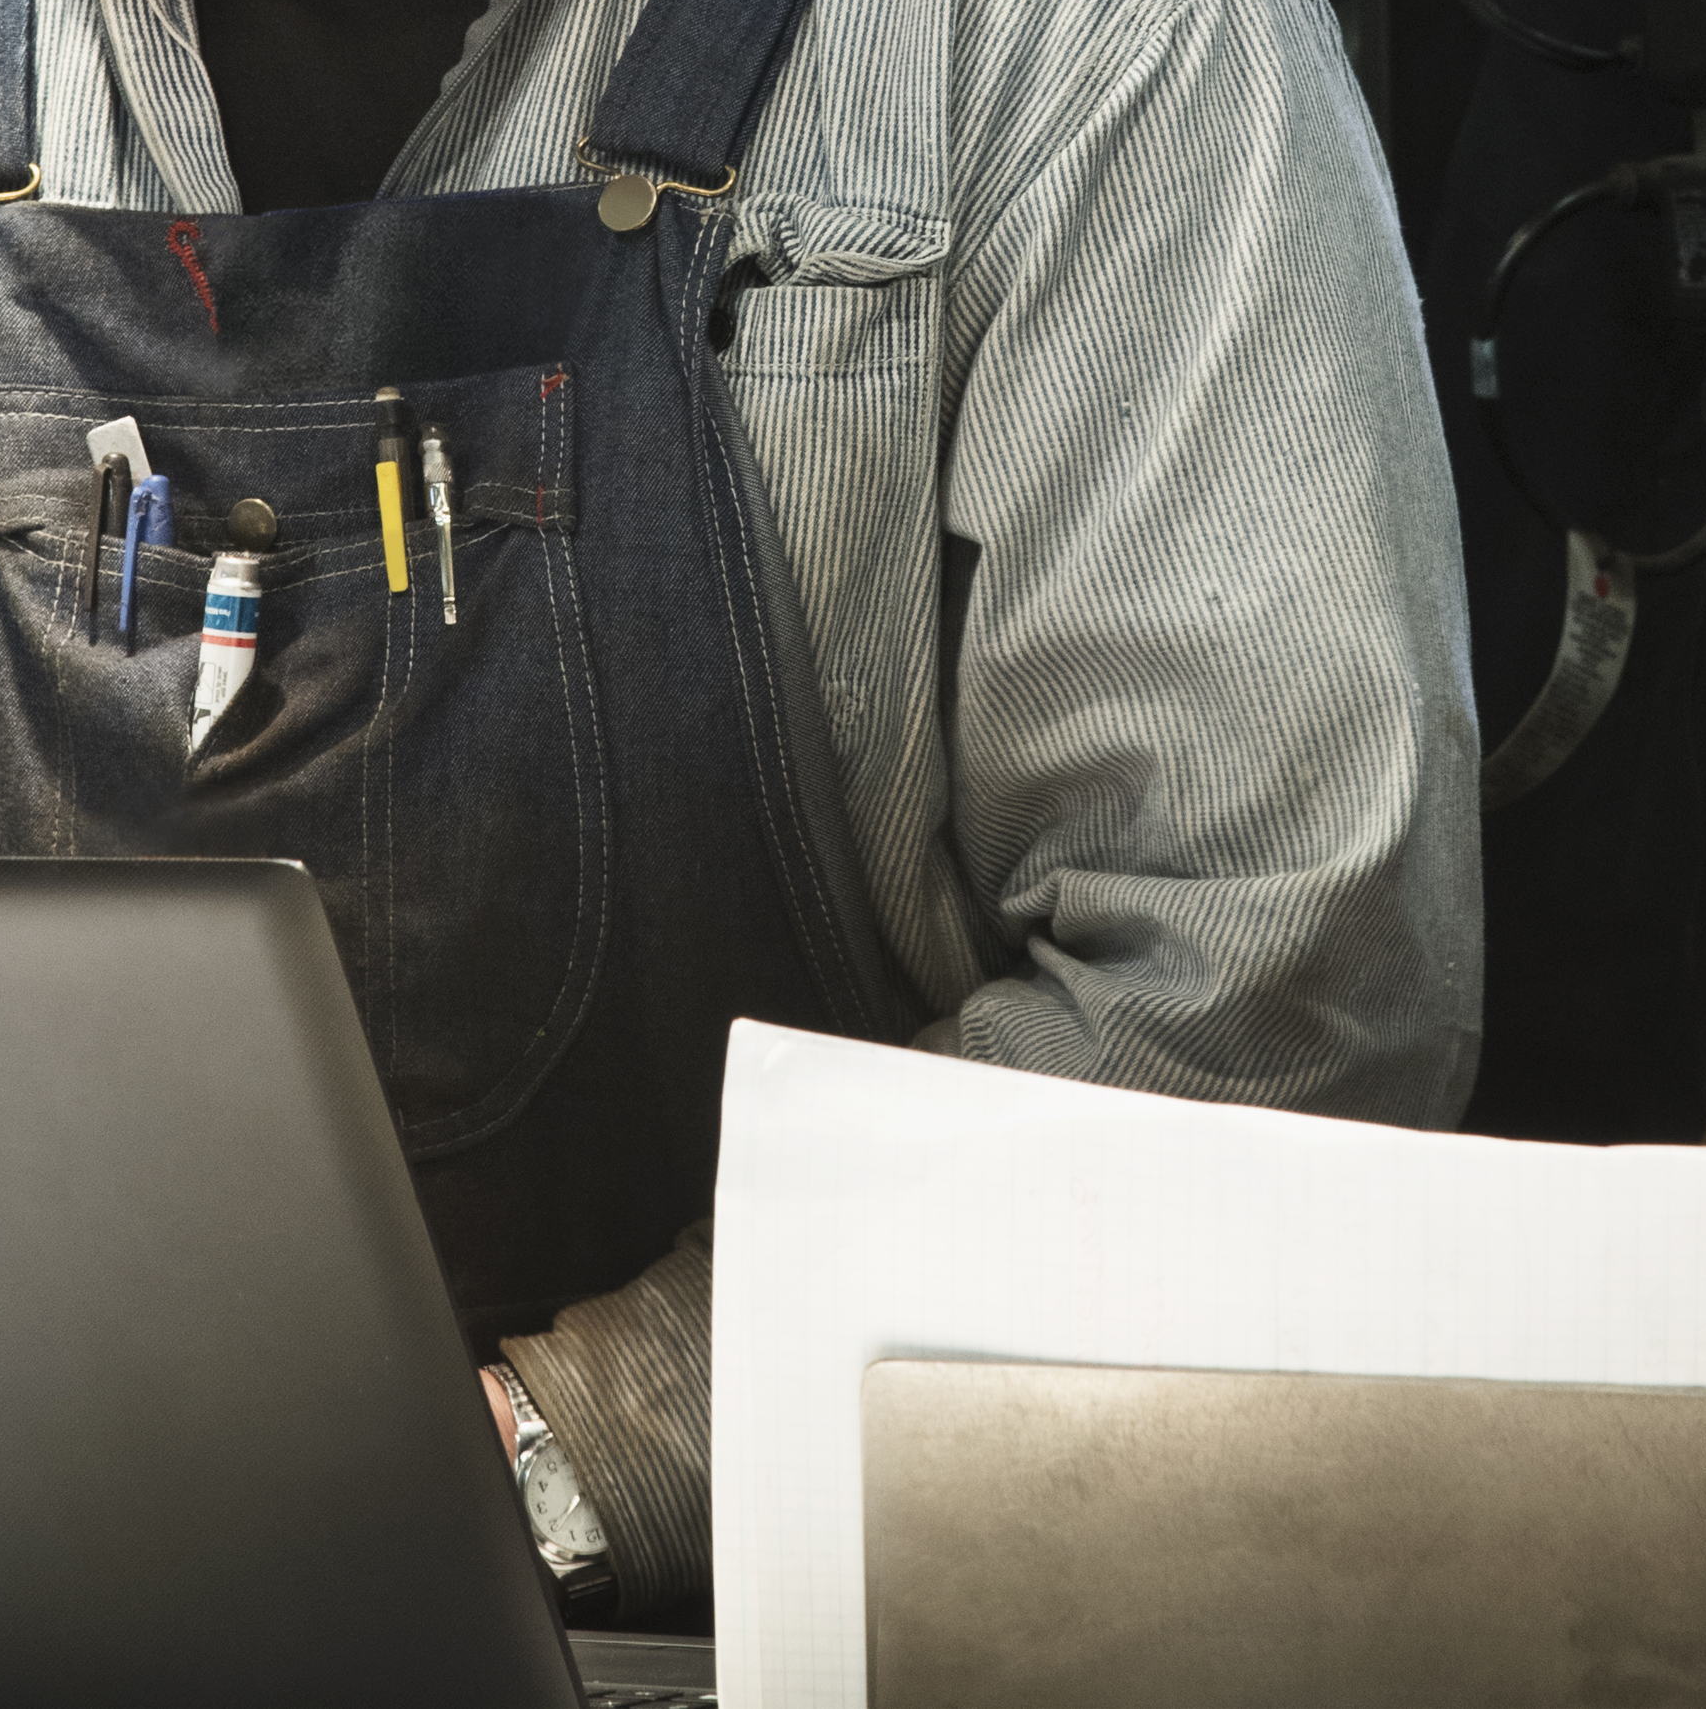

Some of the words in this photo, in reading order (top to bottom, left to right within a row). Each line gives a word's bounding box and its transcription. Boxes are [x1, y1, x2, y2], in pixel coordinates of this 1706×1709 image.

[547, 1461, 558, 1474] 5
[539, 1480, 549, 1493] 4
[537, 1502, 547, 1514] 3
[570, 1529, 576, 1542] 1
[586, 1529, 602, 1543] 12
